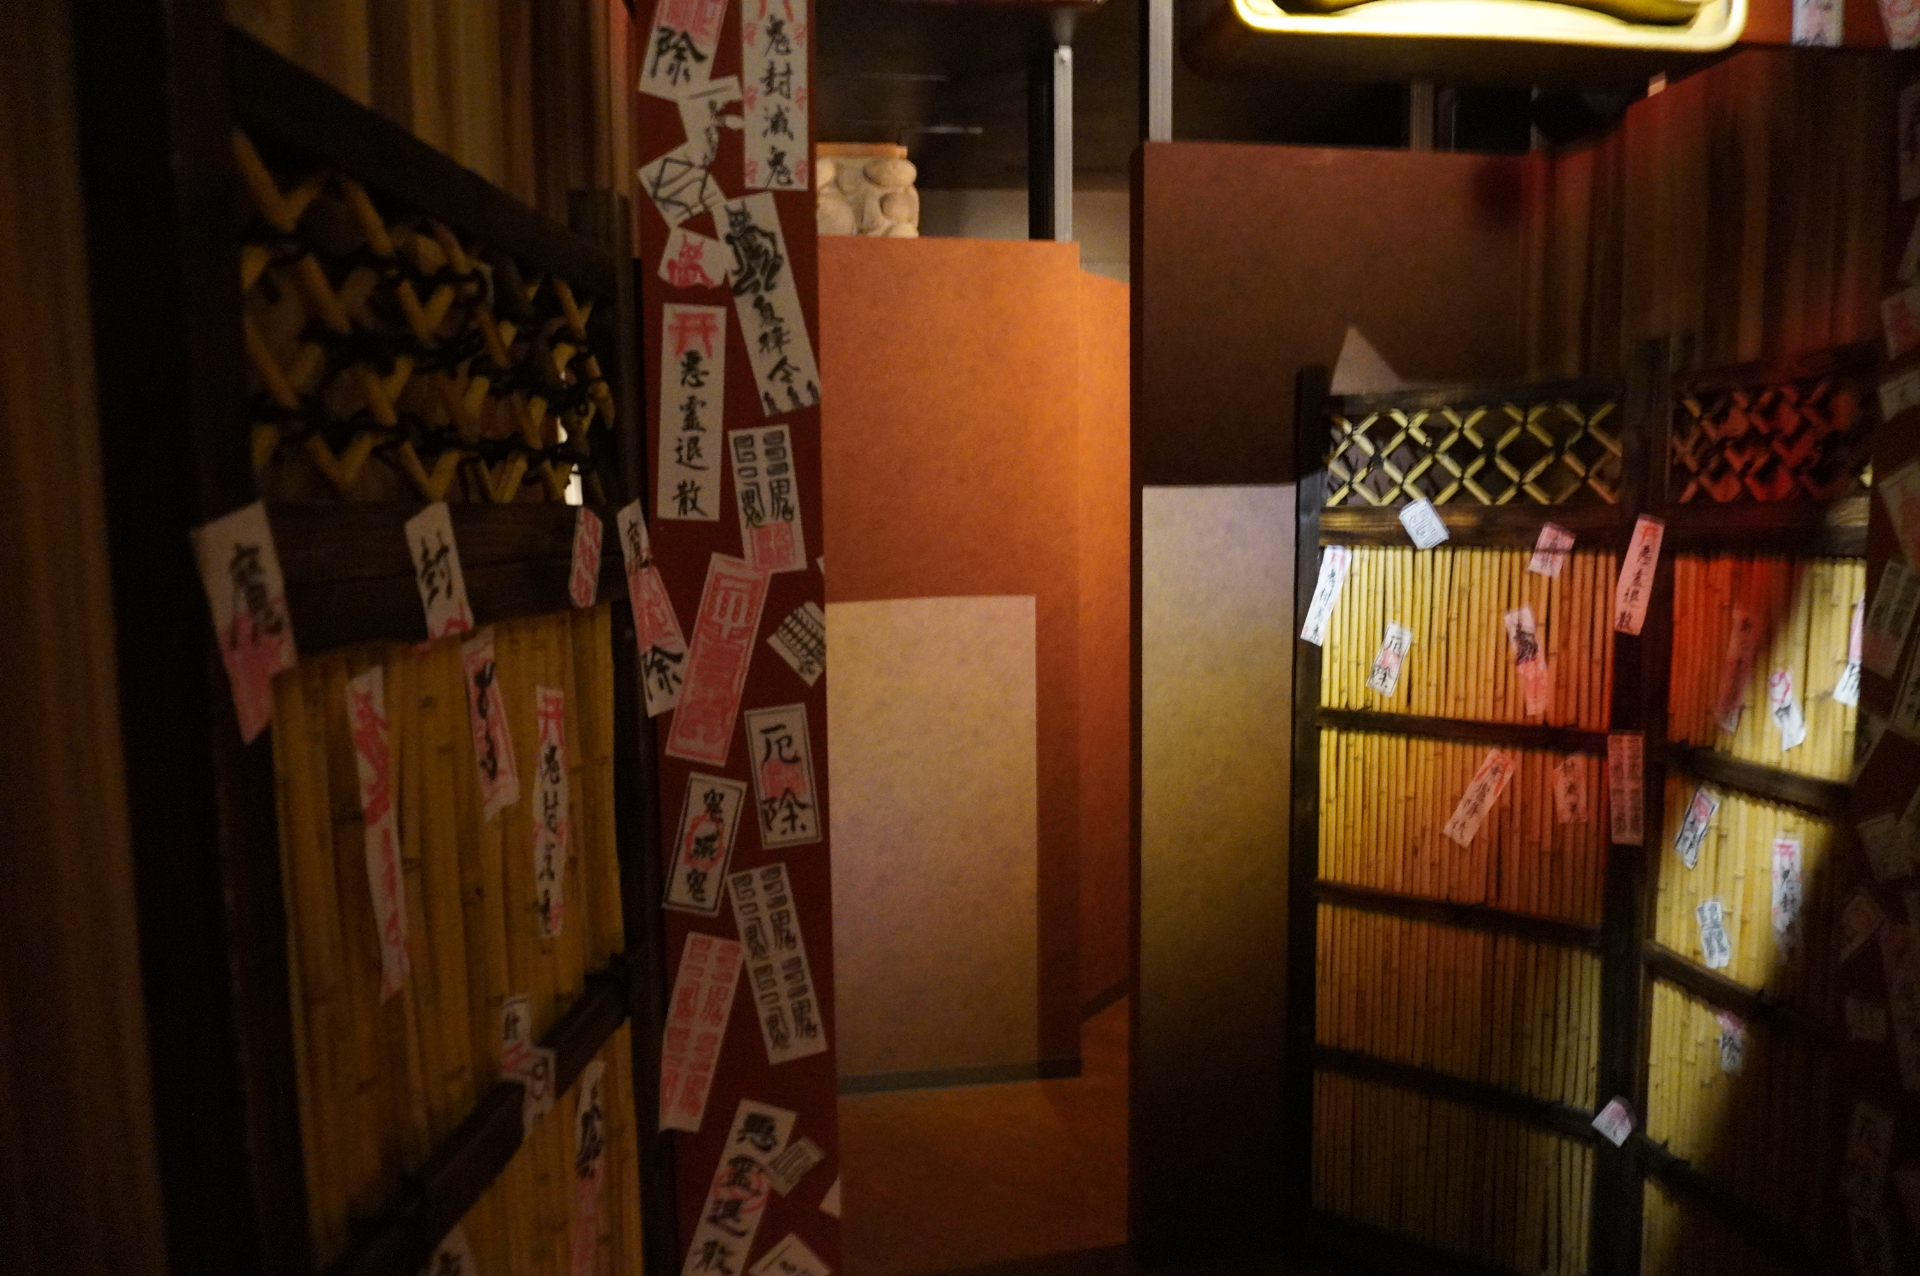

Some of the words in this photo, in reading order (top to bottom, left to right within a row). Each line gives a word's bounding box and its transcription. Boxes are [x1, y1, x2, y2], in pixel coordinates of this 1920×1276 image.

[651, 26, 707, 86] 除
[761, 14, 794, 188] 鬼封滅鬼
[672, 350, 710, 517] 悪霊退散
[759, 723, 809, 833] 厄除
